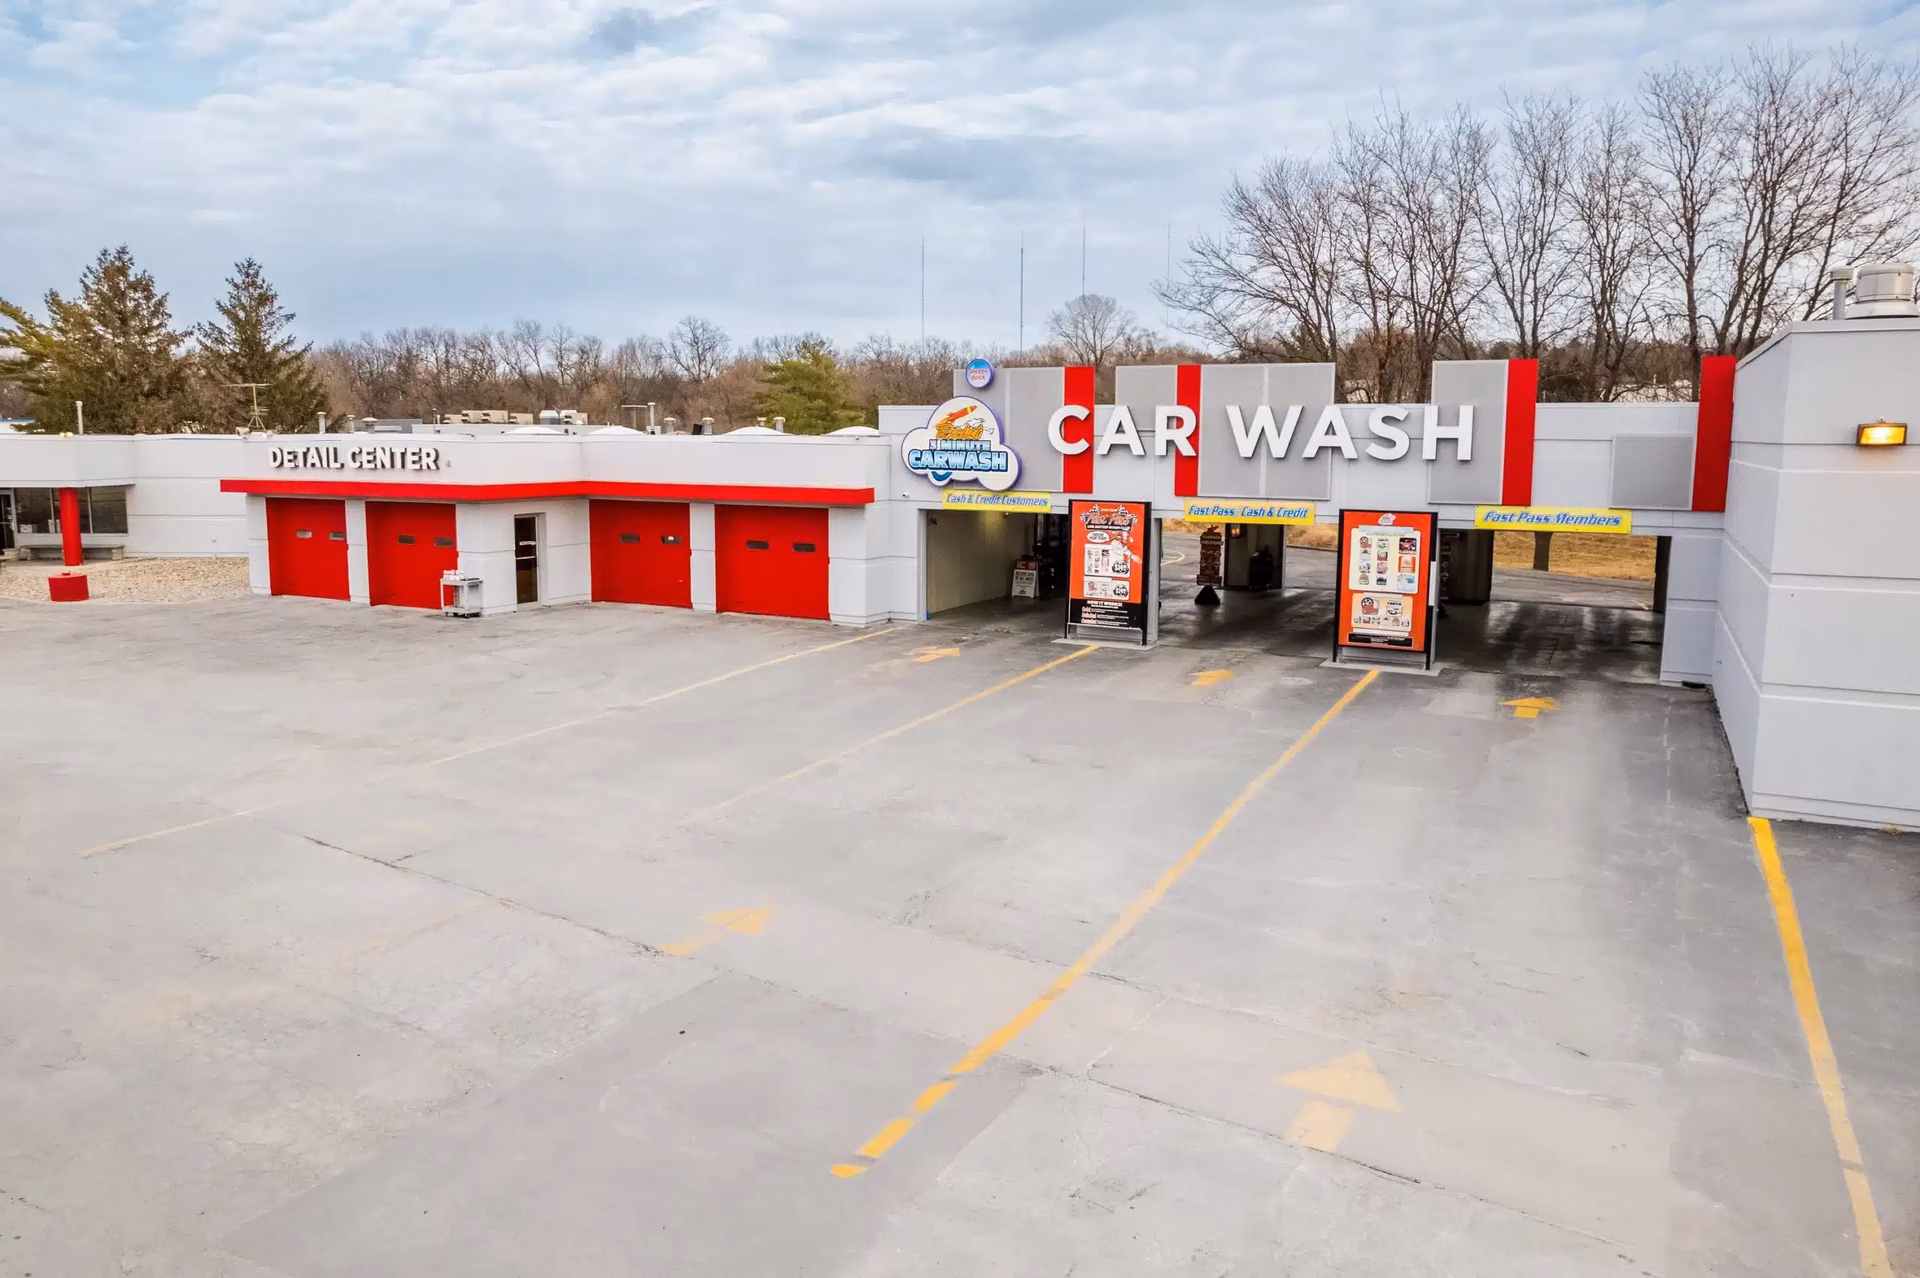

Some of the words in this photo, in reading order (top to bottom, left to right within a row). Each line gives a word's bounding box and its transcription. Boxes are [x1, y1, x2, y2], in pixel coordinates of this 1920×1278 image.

[1047, 405, 1198, 456] CAR
[1225, 405, 1474, 460] WASH
[929, 439, 938, 450] 3
[940, 440, 991, 451] MINUTE
[269, 446, 345, 469] DETAIL
[347, 446, 440, 471] CENTER
[908, 449, 1008, 472] CARWASH
[946, 494, 966, 504] Cash
[966, 494, 974, 504] &
[975, 495, 1000, 505] Credit
[1001, 496, 1048, 506] Customers
[1188, 505, 1210, 516] Fast
[1211, 506, 1235, 517] Pass
[1241, 506, 1265, 517] Cash
[1266, 507, 1275, 517] &
[1276, 507, 1309, 518] Credit
[1484, 511, 1515, 522] Fast
[1517, 512, 1551, 523] Pass
[1554, 513, 1622, 525] Members
